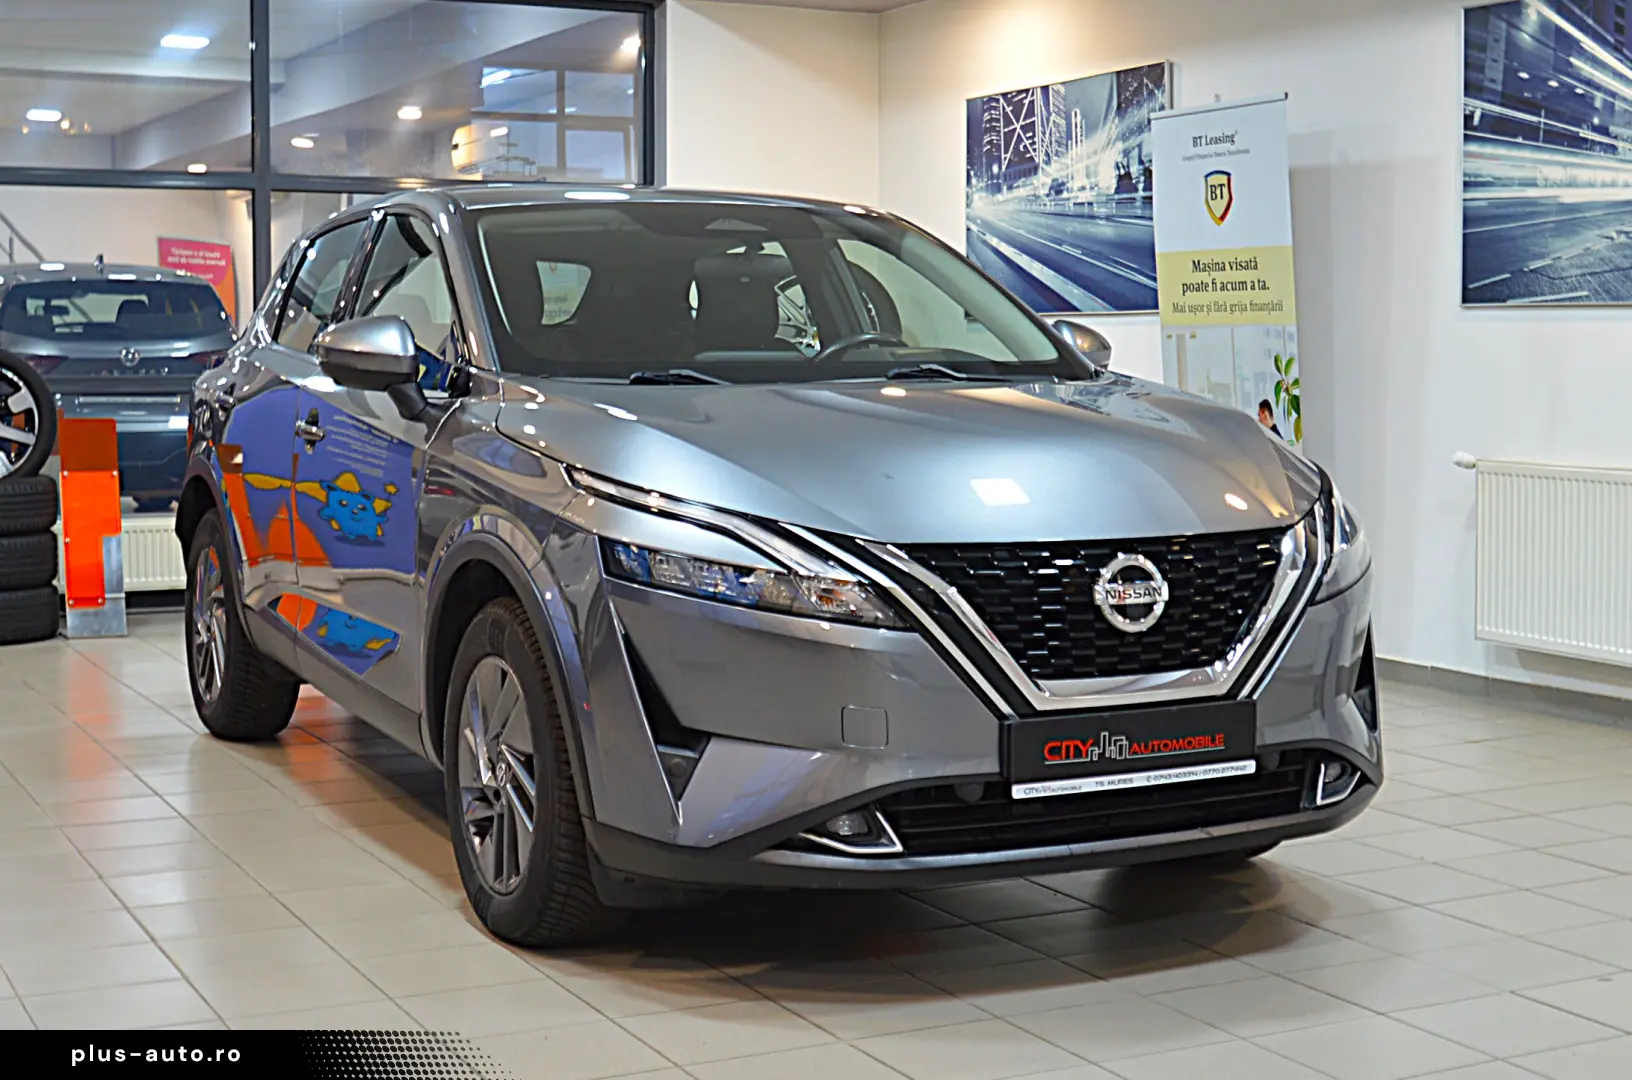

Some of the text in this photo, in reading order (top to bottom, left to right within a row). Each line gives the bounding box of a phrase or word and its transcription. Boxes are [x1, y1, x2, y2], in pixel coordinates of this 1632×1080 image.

[1192, 136, 1203, 148] BT
[1209, 183, 1226, 201] BT
[1192, 256, 1258, 276] Mașina visată
[1182, 277, 1270, 296] poate fi acum a ta.
[1172, 302, 1187, 313] Mai
[1187, 303, 1205, 316] ușor
[1213, 300, 1228, 313] fără
[1229, 299, 1248, 316] grija
[1105, 586, 1162, 601] NISSAN
[1043, 733, 1225, 762] CITY AUTOMOBILE
